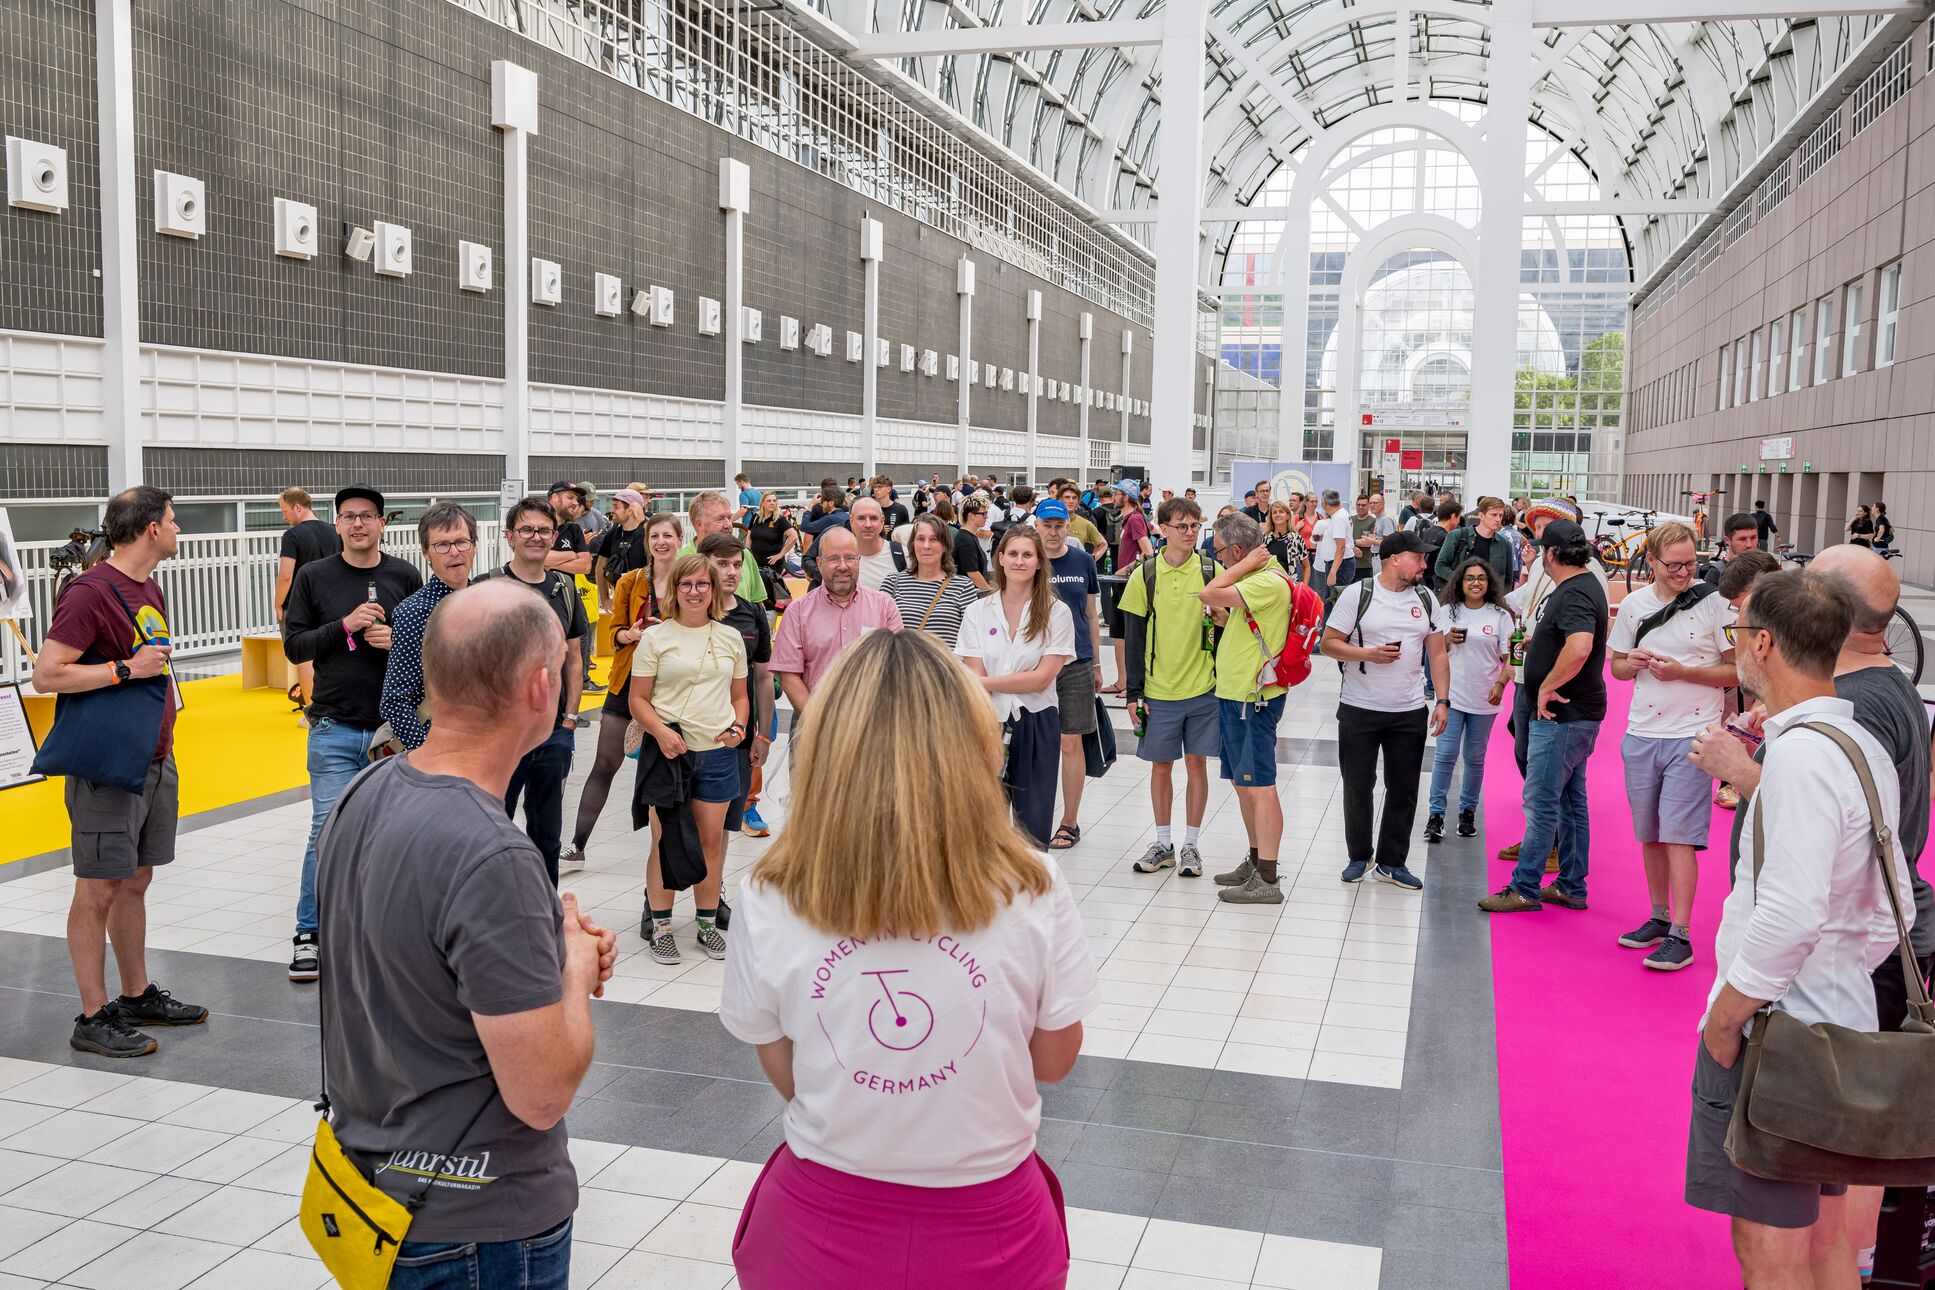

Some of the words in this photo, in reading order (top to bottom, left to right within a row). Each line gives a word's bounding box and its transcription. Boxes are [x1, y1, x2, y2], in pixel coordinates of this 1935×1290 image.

[811, 936, 867, 1000] WOMEN
[910, 927, 988, 989] CYCLING
[853, 1060, 958, 1095] GERMANY
